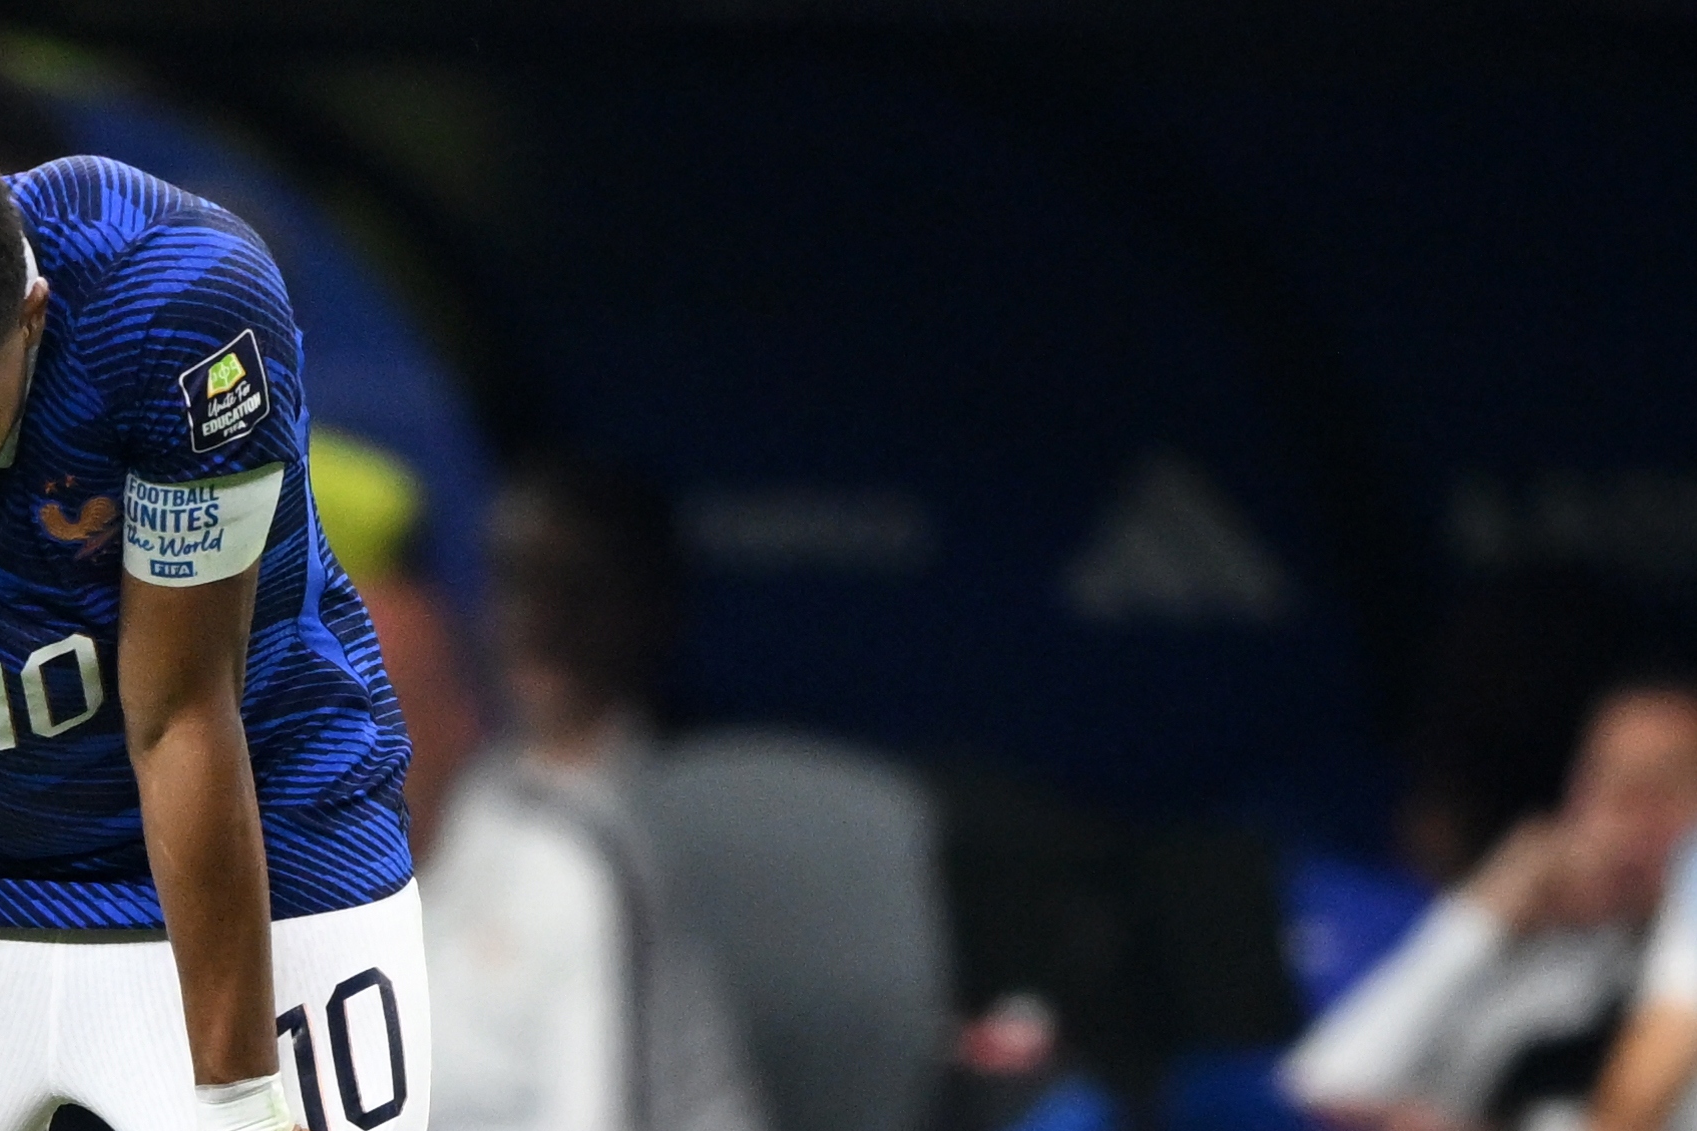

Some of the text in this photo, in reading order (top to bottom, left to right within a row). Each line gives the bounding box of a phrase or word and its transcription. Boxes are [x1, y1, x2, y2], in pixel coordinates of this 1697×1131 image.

[202, 391, 261, 437] EDUCATION
[207, 379, 251, 418] Unite For
[223, 420, 246, 437] FIFA
[129, 477, 220, 507] FOOTBALL
[127, 496, 220, 534] UNITES
[127, 524, 224, 557] the World
[152, 562, 192, 576] FIFA
